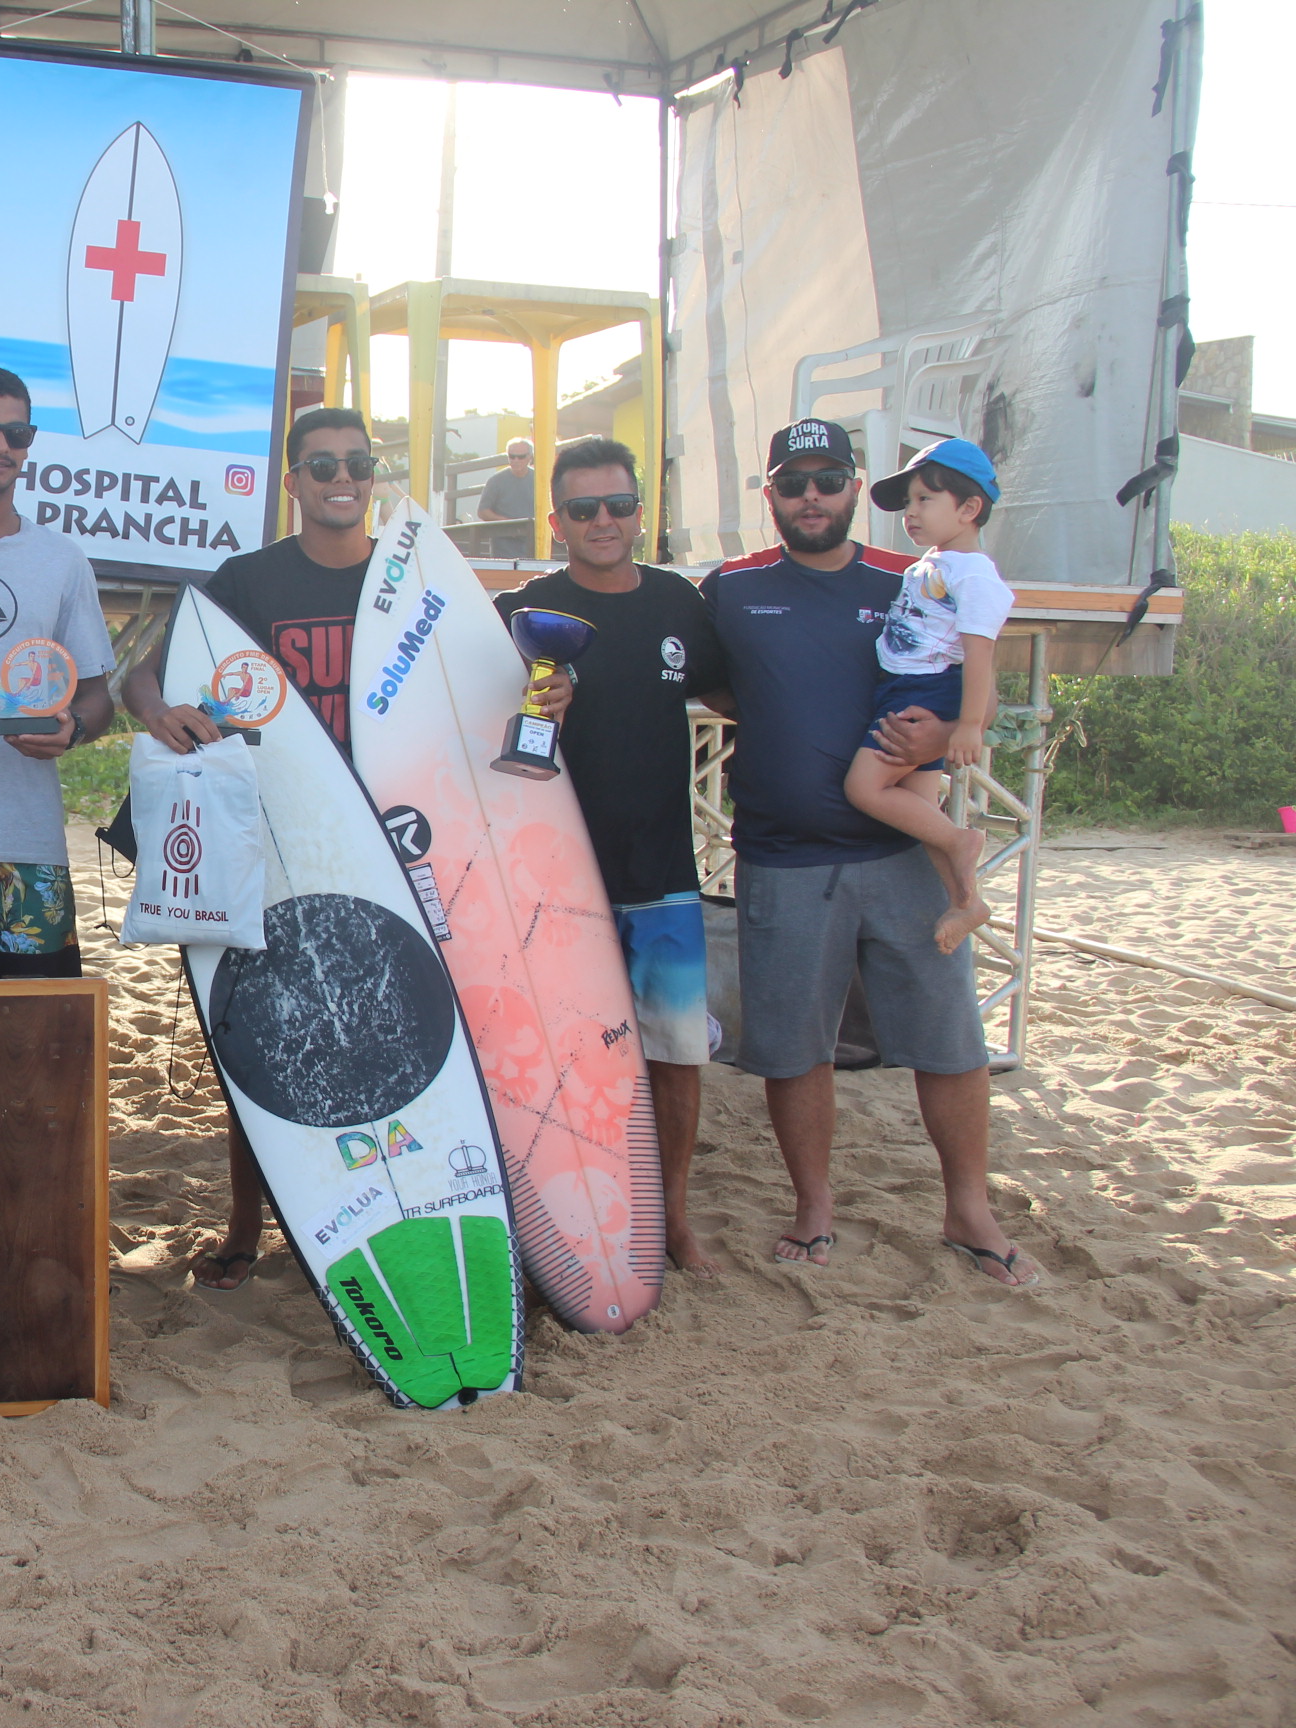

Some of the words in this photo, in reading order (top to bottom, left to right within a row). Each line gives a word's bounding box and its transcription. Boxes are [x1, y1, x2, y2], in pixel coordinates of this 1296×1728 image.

[789, 422, 828, 439] ATURA
[788, 434, 829, 452] SURTA
[15, 461, 207, 511] HOSPITAL
[36, 500, 241, 552] PRANCHA
[373, 520, 422, 614] EVOLUA
[6, 642, 30, 664] CIRCUITO
[219, 652, 244, 673] CIRCUITO
[366, 589, 446, 715] SoluMedi
[661, 669, 685, 682] STAFF
[139, 902, 162, 916] TRUE
[167, 906, 190, 919] YOU
[195, 910, 229, 922] BRASIL
[314, 1186, 384, 1246] EVOLUA
[403, 1206, 421, 1220] TR
